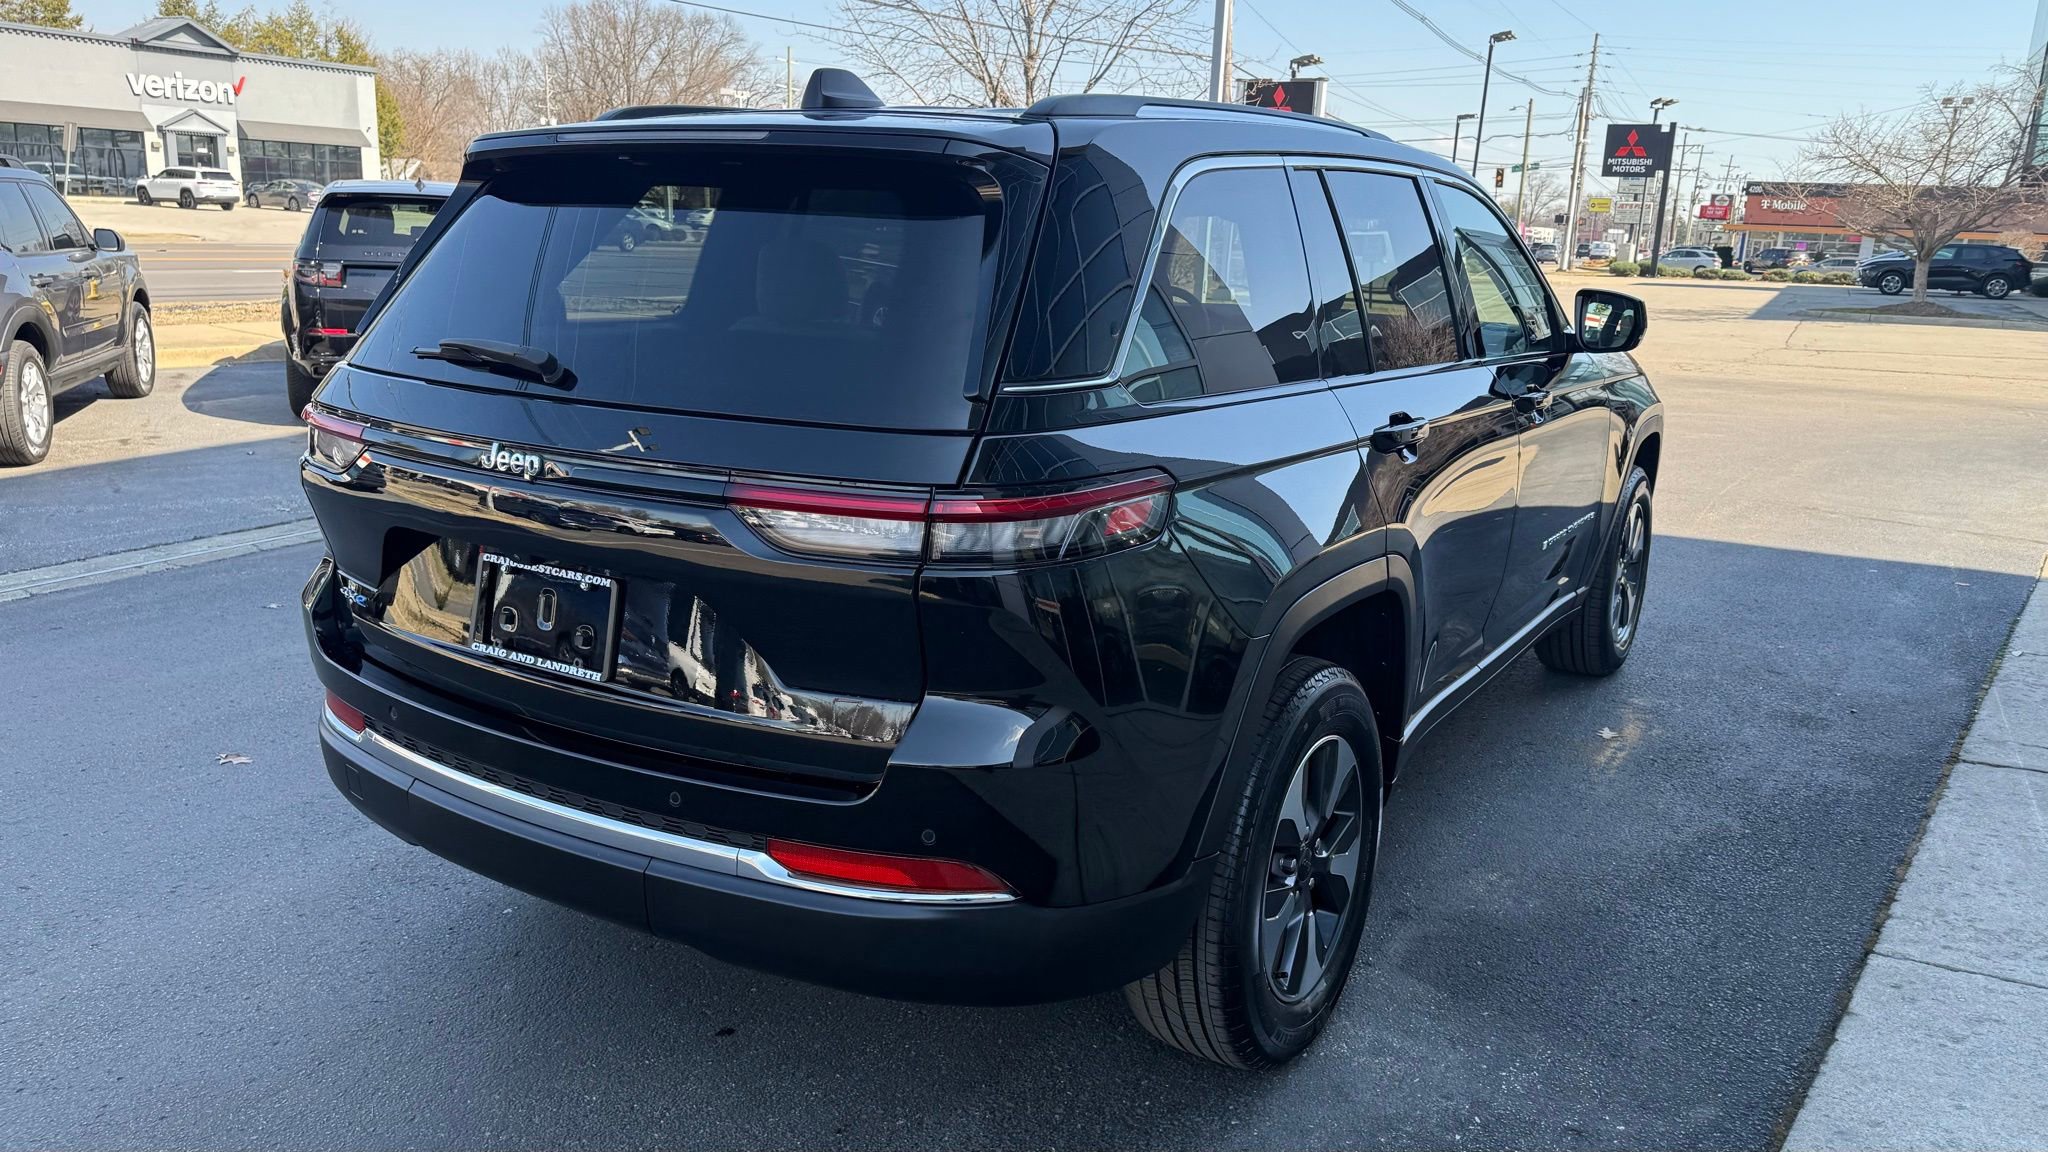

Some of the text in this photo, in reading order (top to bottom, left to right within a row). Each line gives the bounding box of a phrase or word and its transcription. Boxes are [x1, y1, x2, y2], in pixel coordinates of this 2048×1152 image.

[126, 71, 235, 105] verizon
[1607, 158, 1653, 166] MITSUBISHI
[1612, 165, 1646, 173] MOTORS
[1772, 199, 1807, 211] Mobile
[481, 441, 544, 481] Jeep
[471, 642, 602, 682] CRAIG AND LANDRETH
